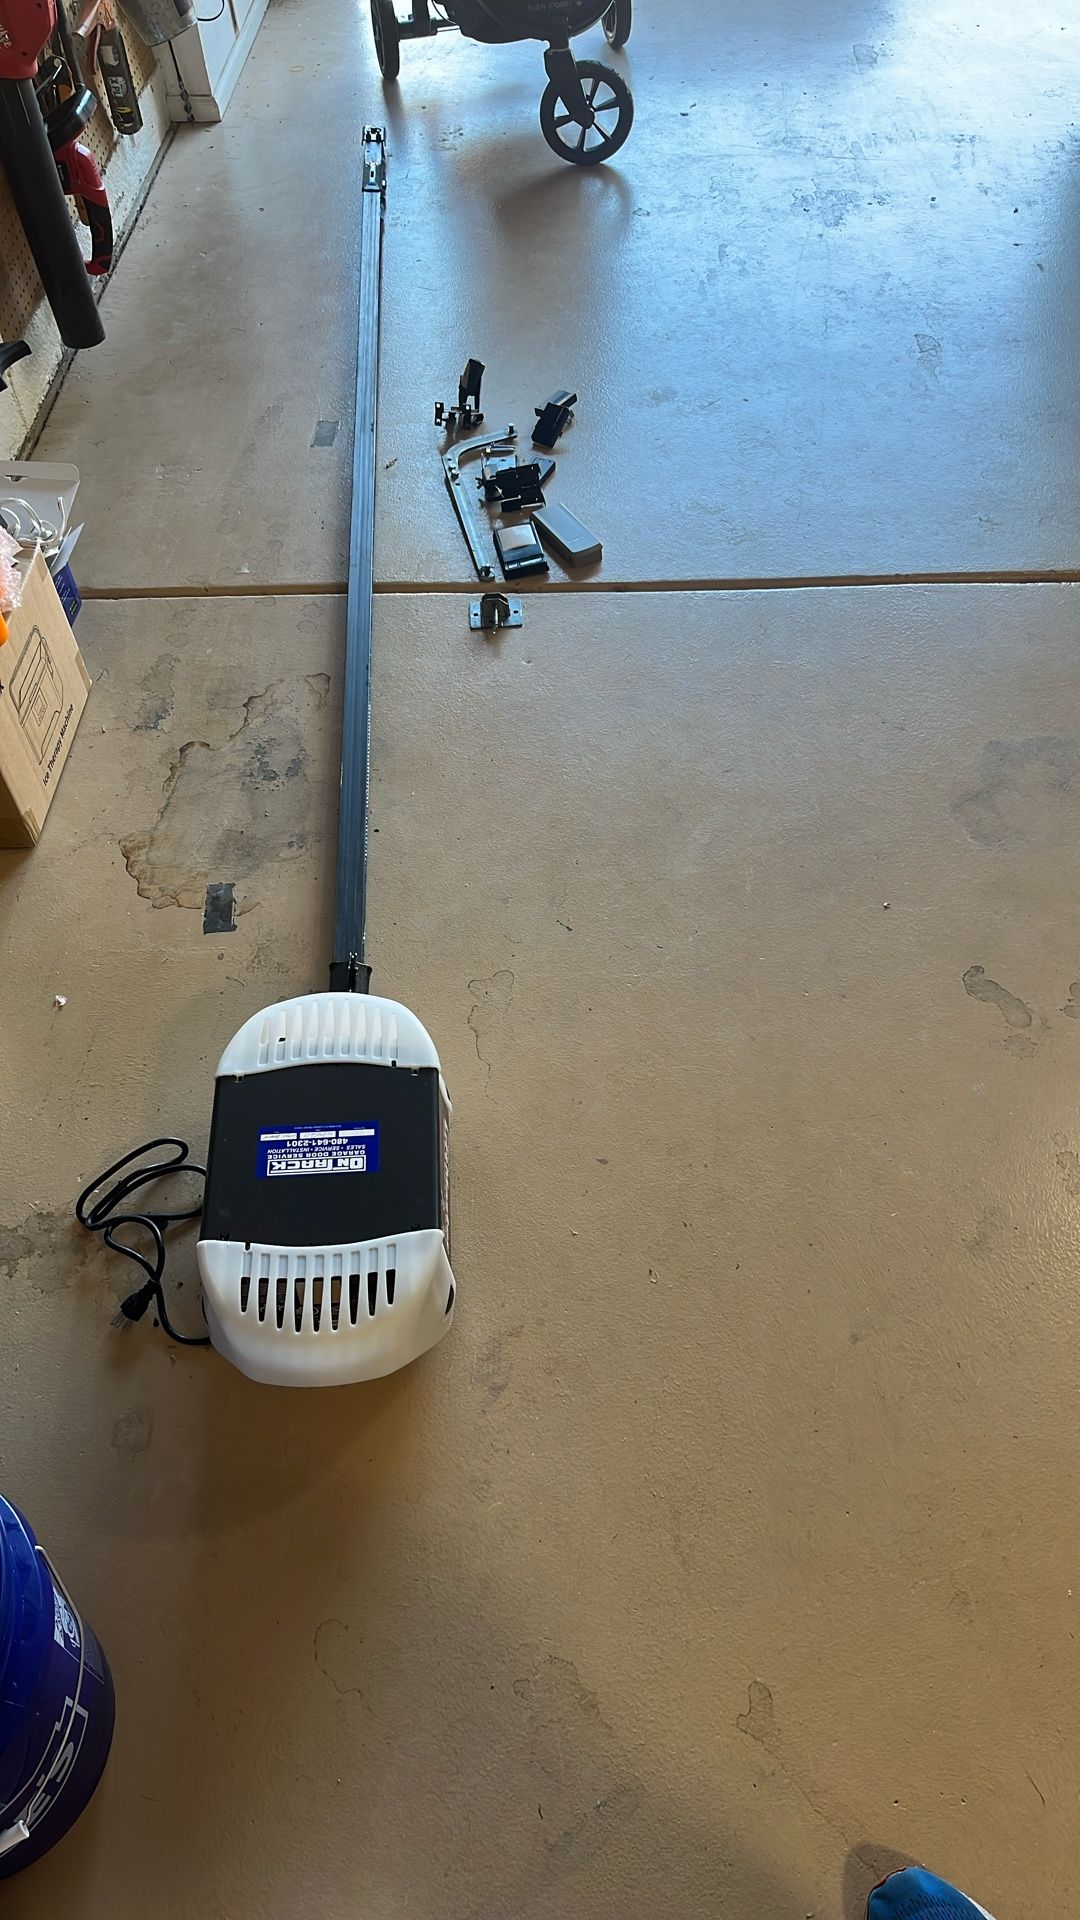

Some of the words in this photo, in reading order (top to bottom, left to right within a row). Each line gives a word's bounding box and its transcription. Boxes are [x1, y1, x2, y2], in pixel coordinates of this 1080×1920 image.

[42, 771, 50, 787] Ice
[47, 737, 63, 772] Therapy
[59, 704, 74, 739] Machine
[286, 1138, 349, 1147] 480-641-2301
